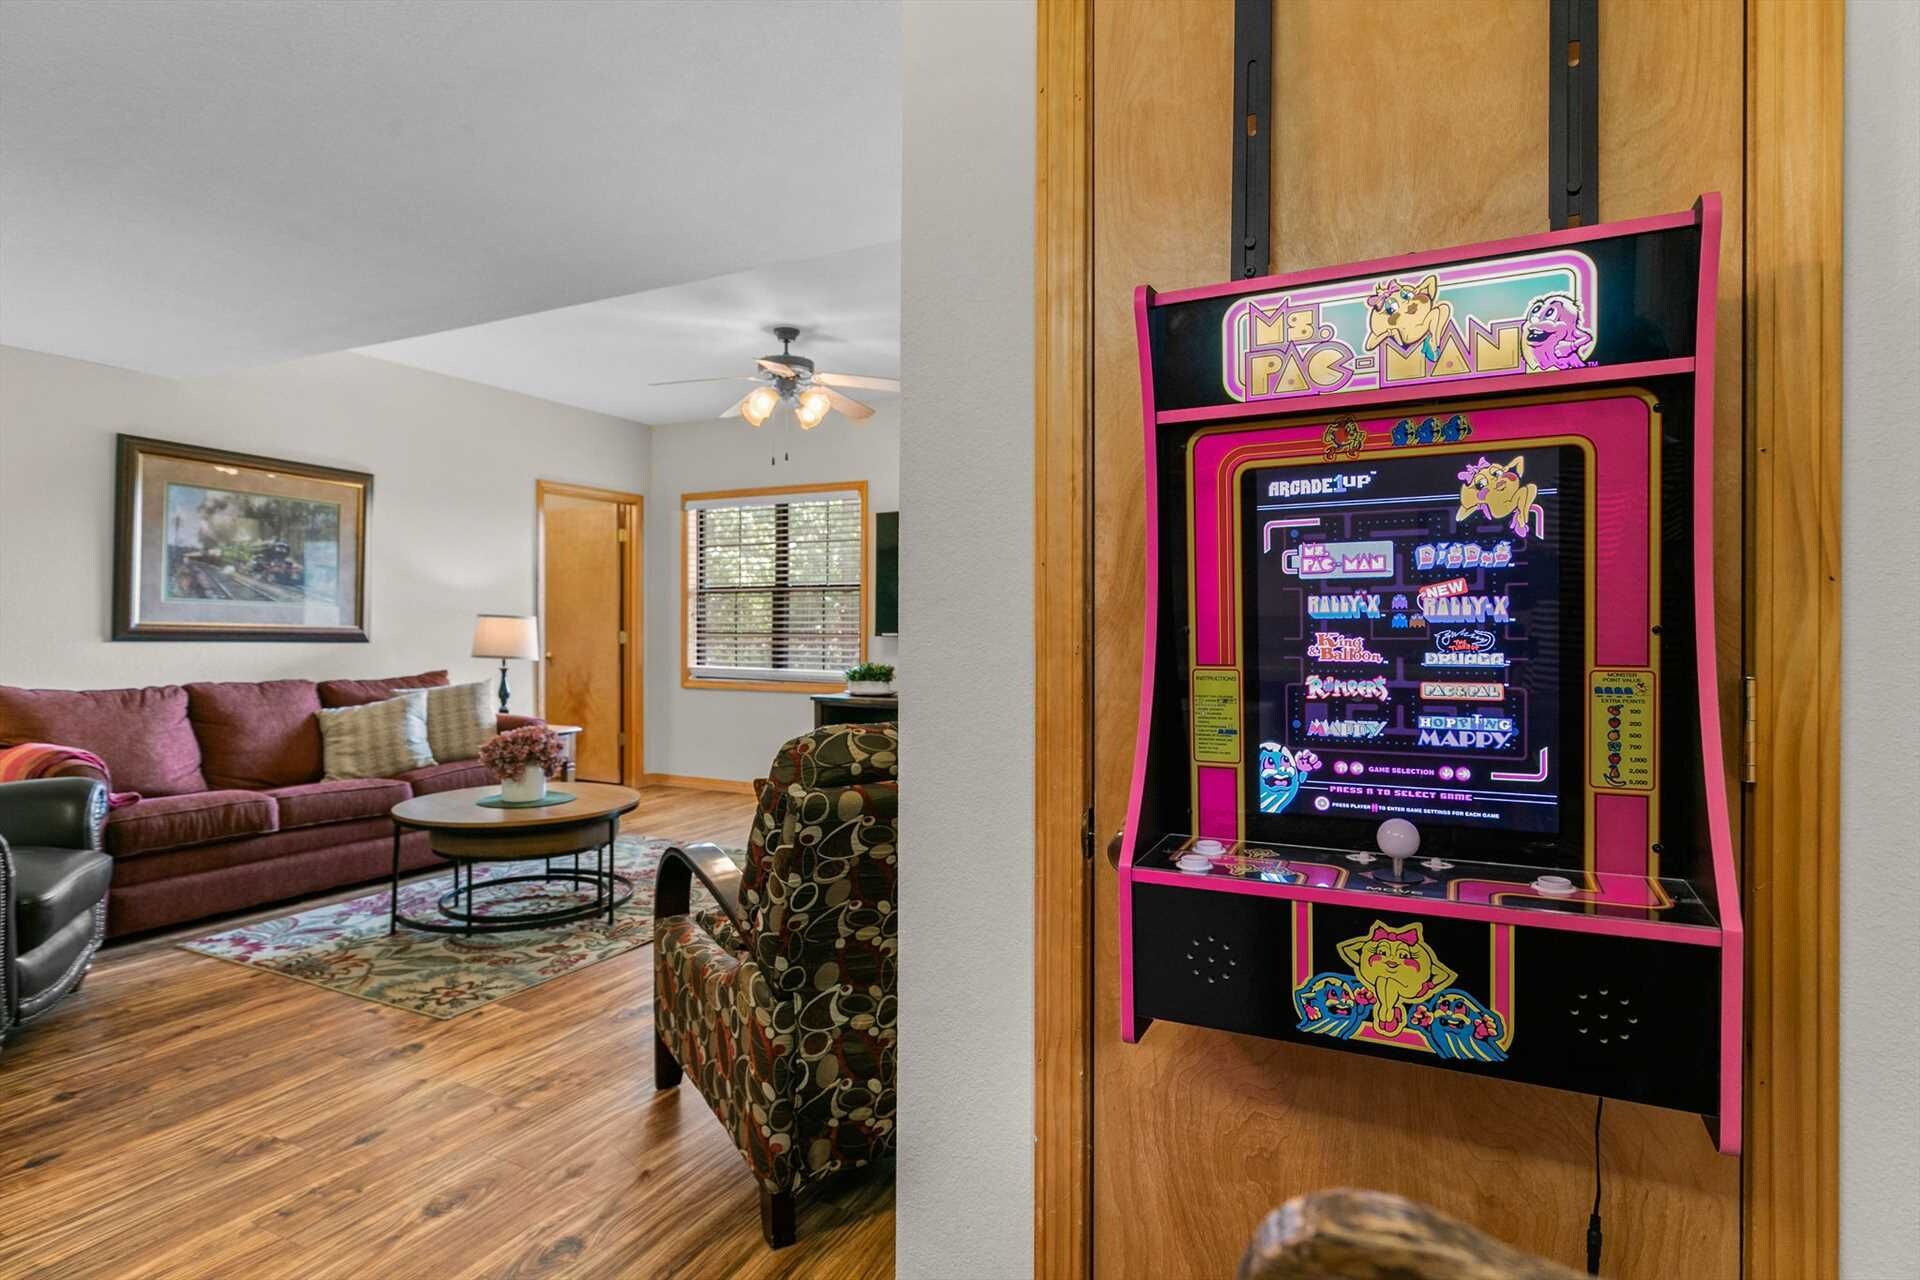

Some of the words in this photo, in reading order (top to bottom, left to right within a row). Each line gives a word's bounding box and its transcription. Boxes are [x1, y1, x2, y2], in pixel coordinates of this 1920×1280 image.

[1247, 320, 1523, 399] PAC-MAN
[1302, 554, 1386, 573] PAC-MAN
[1425, 581, 1463, 598] NEW
[1308, 594, 1380, 618] RALLY-X
[1422, 596, 1509, 622] RALLY-X
[1315, 633, 1364, 652] King
[1319, 646, 1382, 664] Balloon
[1307, 719, 1387, 738] MAPPY
[1419, 714, 1512, 731] HOPPING
[1417, 730, 1512, 749] MAPPY
[1391, 767, 1435, 776] SELECTION
[1329, 785, 1363, 795] PRESS
[1394, 790, 1436, 799] SELECT
[1440, 793, 1473, 801] GAME
